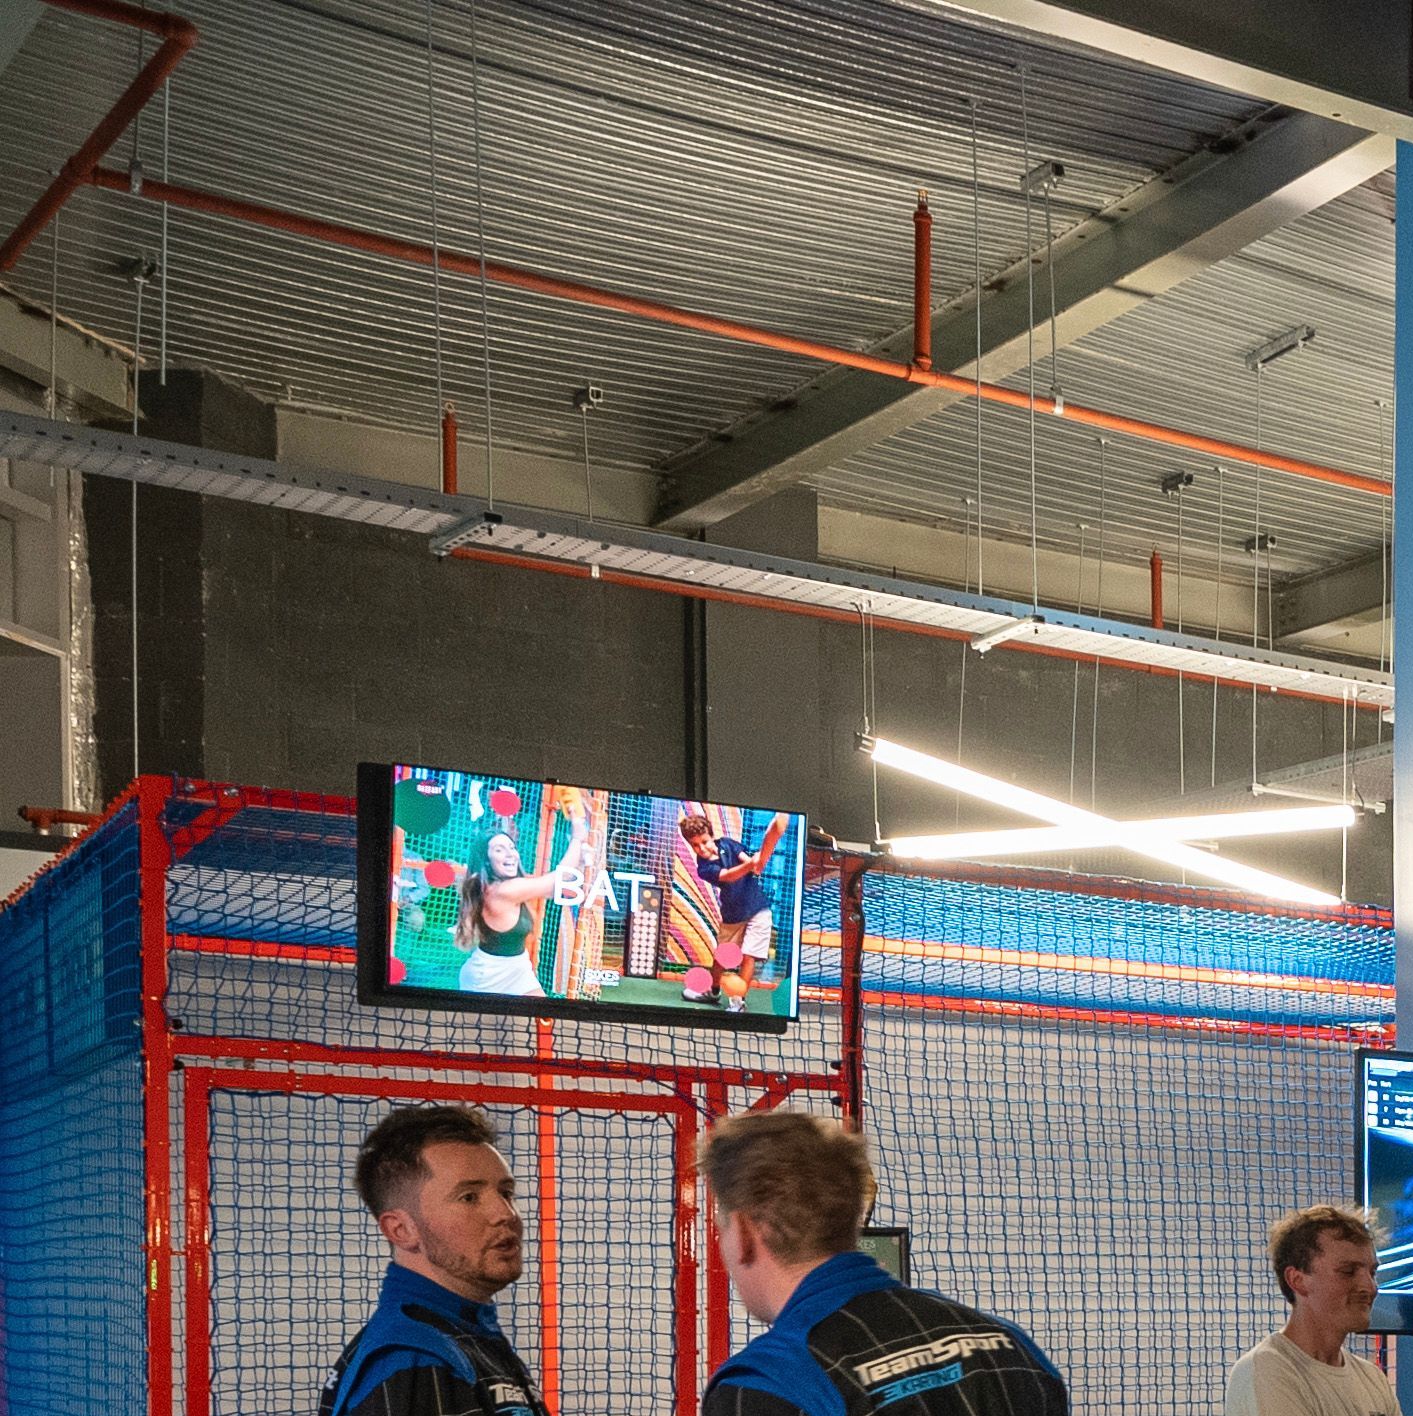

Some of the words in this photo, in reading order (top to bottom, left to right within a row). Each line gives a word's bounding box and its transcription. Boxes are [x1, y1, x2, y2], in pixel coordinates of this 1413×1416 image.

[554, 865, 656, 912] BAT
[853, 1333, 1015, 1386] TeamSport
[901, 1366, 962, 1395] KARTING
